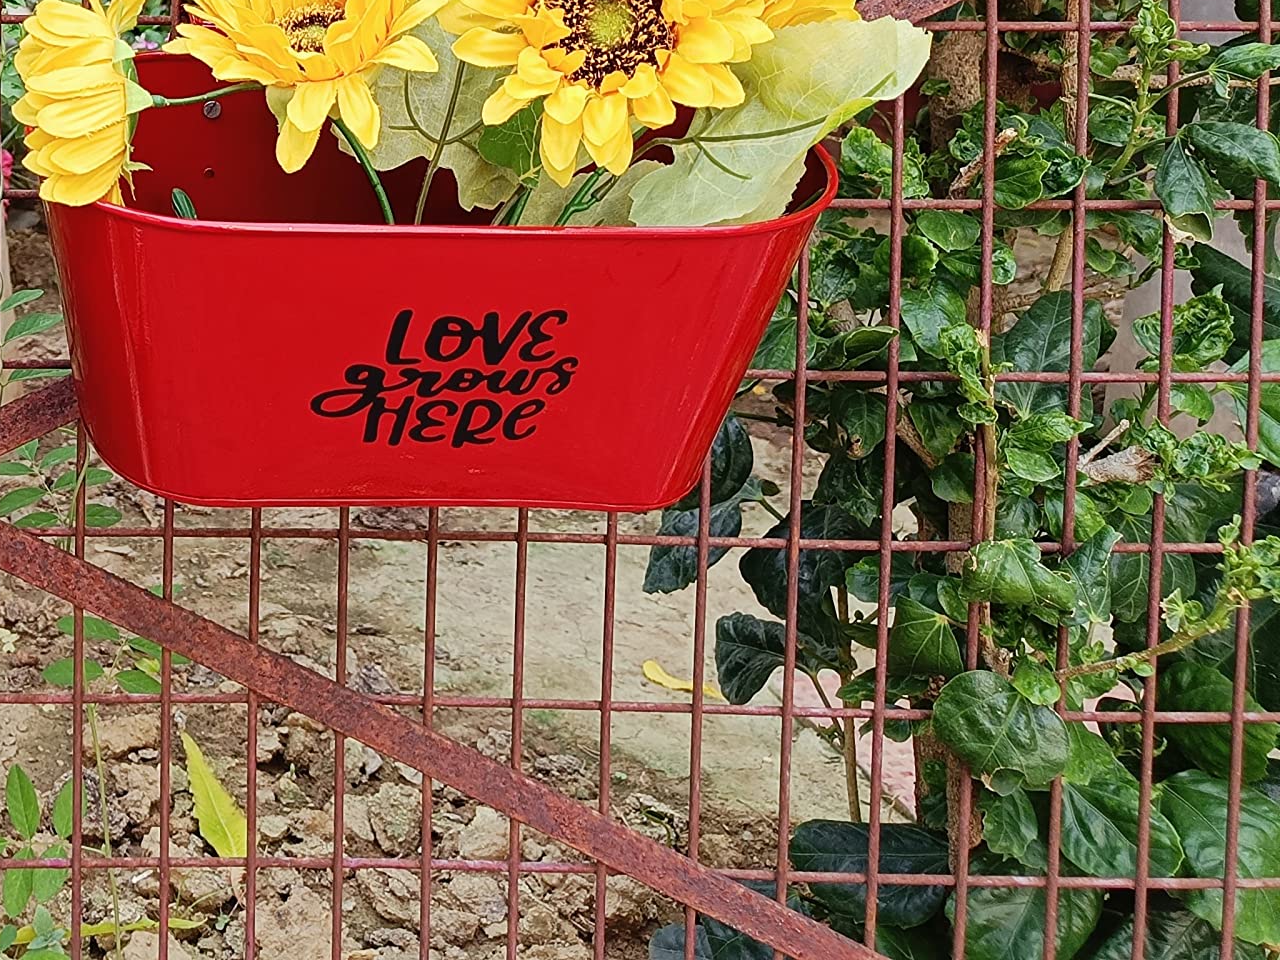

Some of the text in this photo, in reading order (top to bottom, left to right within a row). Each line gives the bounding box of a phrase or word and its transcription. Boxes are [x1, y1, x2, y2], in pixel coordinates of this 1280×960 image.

[385, 308, 569, 366] LOVE
[310, 356, 579, 418] grows
[362, 395, 546, 449] HERE
